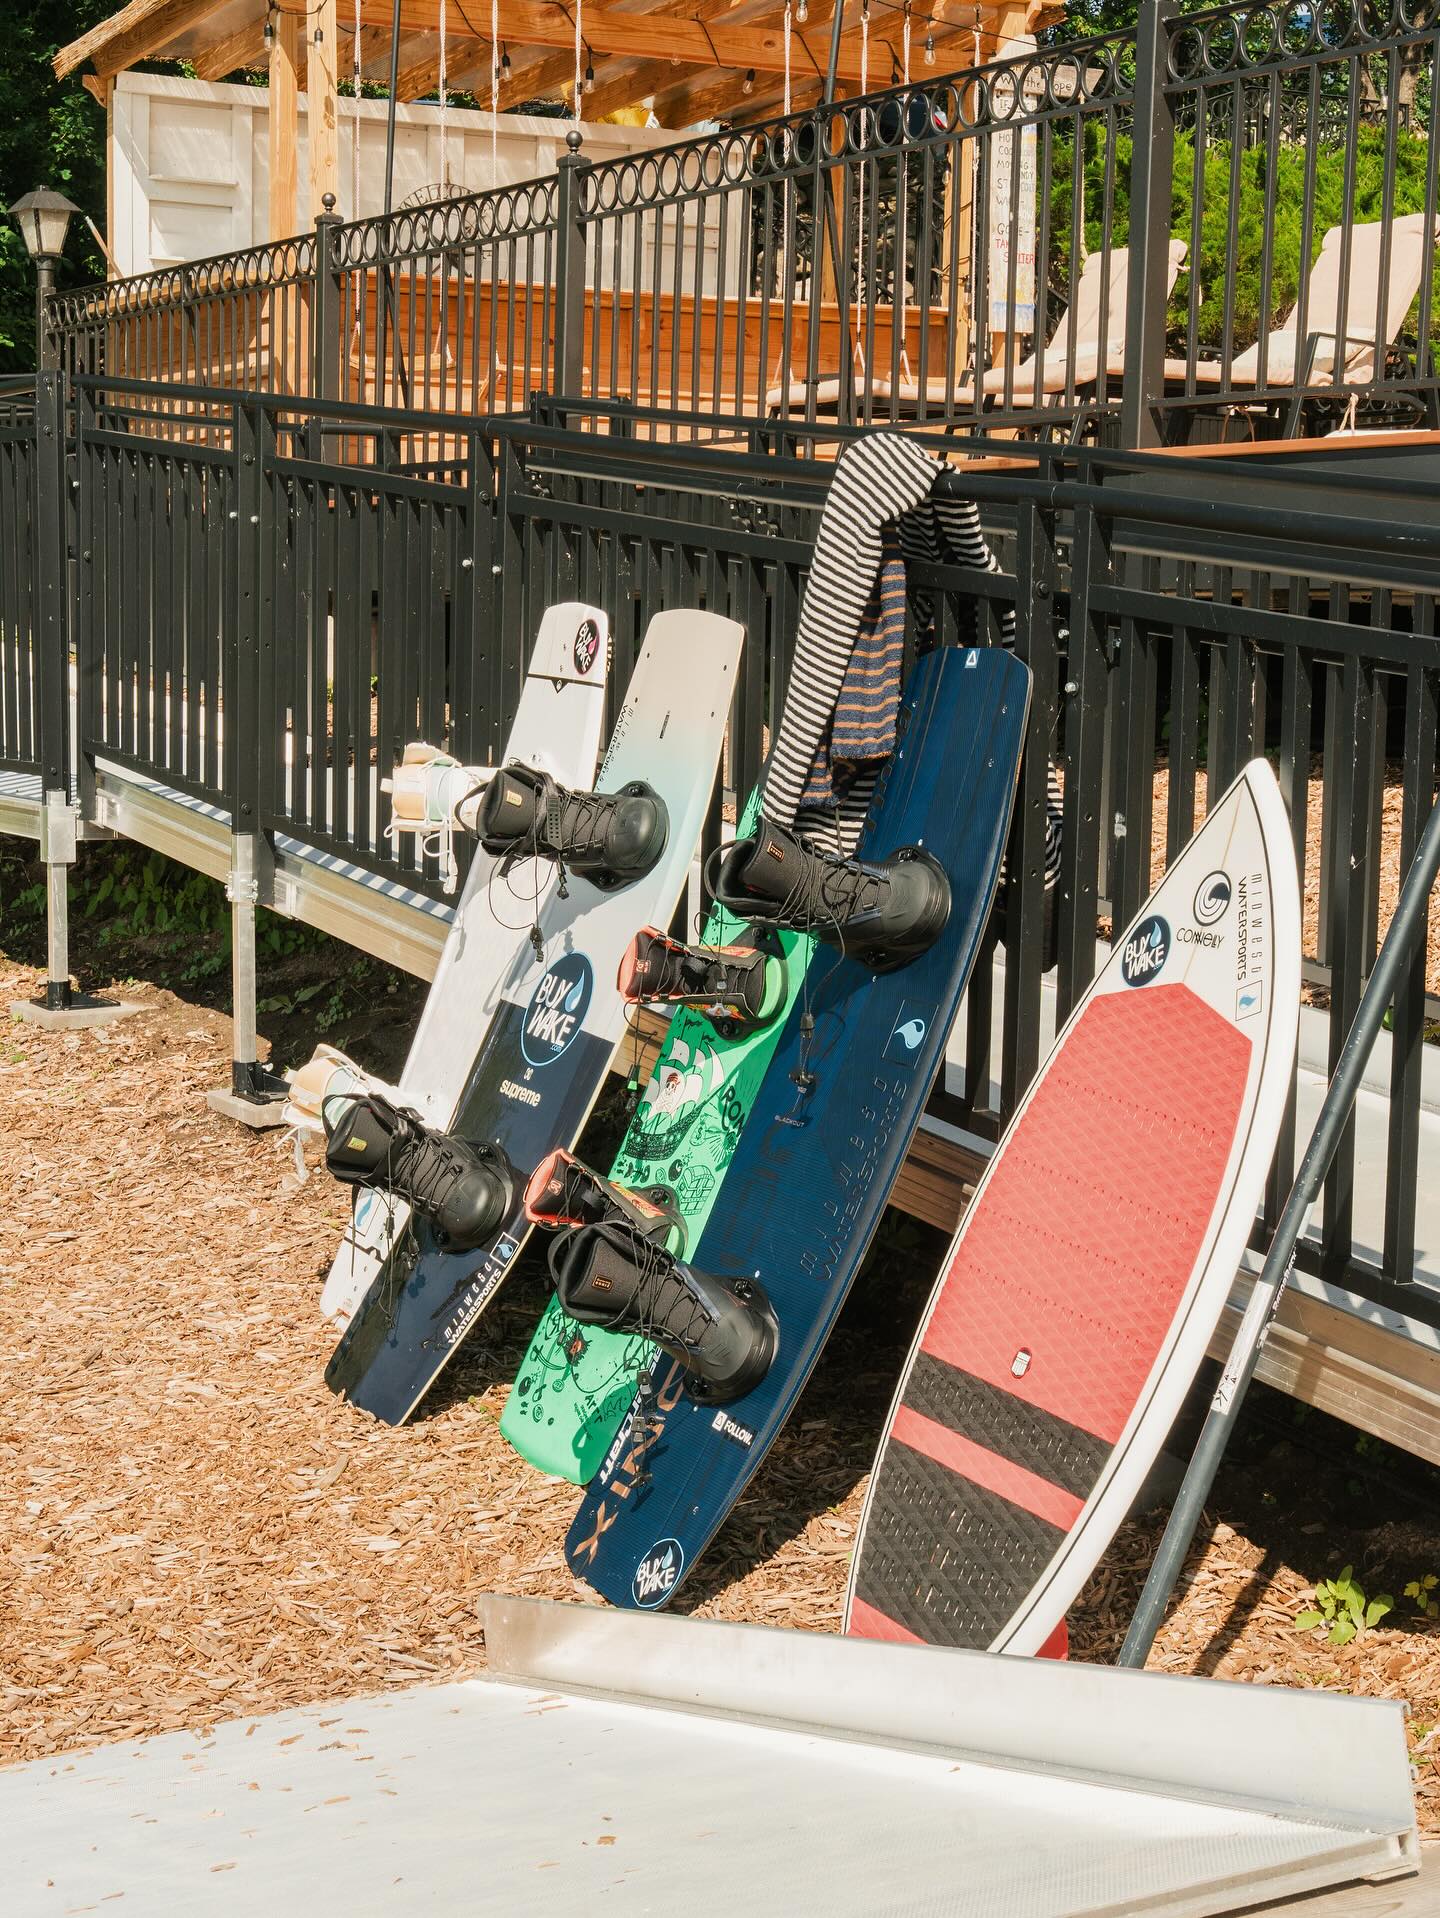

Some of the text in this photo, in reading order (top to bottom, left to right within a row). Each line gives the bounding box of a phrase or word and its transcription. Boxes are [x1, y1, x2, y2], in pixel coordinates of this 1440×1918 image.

[1053, 82, 1072, 95] ope
[1237, 876, 1248, 981] WATERSPORTS
[1125, 932, 1151, 962] BUY
[1128, 944, 1165, 979] WAKE
[535, 973, 574, 1008] BUY
[526, 1007, 576, 1047] WAKE
[499, 1079, 541, 1107] supreme
[447, 1268, 502, 1344] WATERSPORTS
[637, 1556, 665, 1583] BUY
